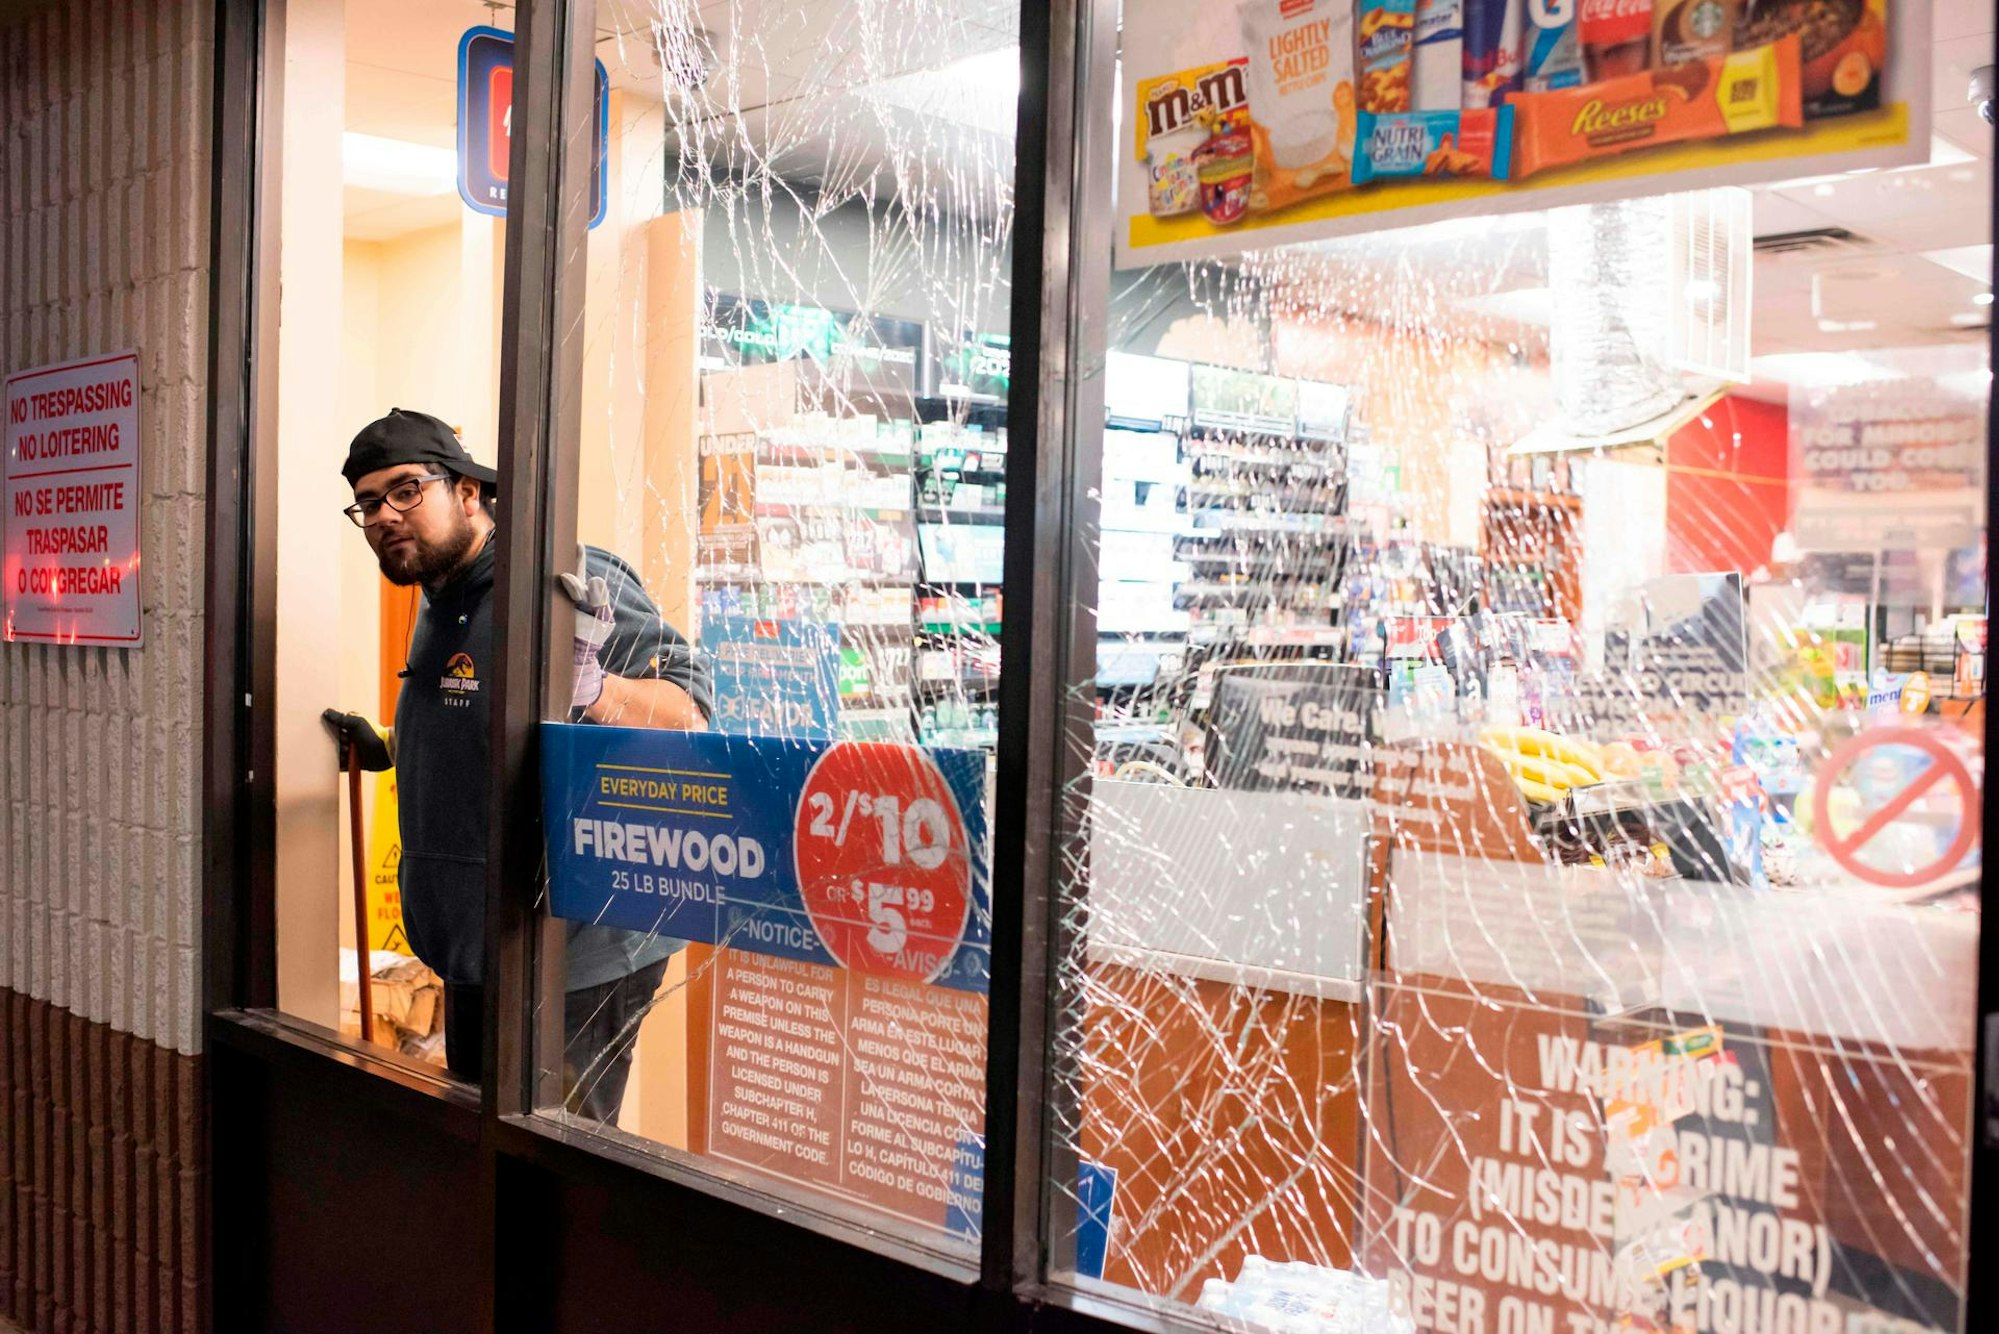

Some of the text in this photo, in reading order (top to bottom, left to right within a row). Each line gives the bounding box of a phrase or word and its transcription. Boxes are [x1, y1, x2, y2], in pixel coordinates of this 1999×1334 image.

[1269, 16, 1330, 60] LIGHTLY
[1273, 46, 1330, 84] SALTED
[1372, 144, 1423, 163] GRAIN
[1373, 126, 1425, 146] NUTRI
[10, 378, 133, 424] NO TRESPASSING
[19, 423, 120, 462] NO LOITERING
[15, 482, 124, 517] NO SE PERMITE
[26, 525, 109, 555] TRASPASAR
[18, 566, 121, 595] O CONGREGAR
[600, 776, 728, 806] EVERYDAY PRICE
[573, 817, 765, 880] FIREWOOD
[611, 870, 726, 907] 25 LB BUNDLE
[728, 948, 833, 981] IT IS UNLAWFUL FOR
[727, 968, 834, 1002] A PERSON TO CARRY
[865, 978, 980, 1014] ES ILEGAL QUE UNA
[730, 988, 829, 1022] A WEAPON ON THIS
[862, 998, 919, 1024] PERSONA
[920, 1010, 961, 1033] PORTE
[723, 1005, 836, 1044] PREMISE UNLESS THE
[851, 1017, 981, 1060] ARMA EN ESTE LUGAR
[719, 1023, 840, 1066] WEAPON IS A HANDGUN
[858, 1038, 986, 1082] MENOS QUE EL ARMA
[727, 1045, 829, 1084] AND THE PERSON IS
[732, 1065, 821, 1102] LICENSED UNDER
[853, 1060, 876, 1076] SEA
[878, 1065, 895, 1081] UN
[898, 1070, 933, 1091] ARMA
[934, 1079, 976, 1101] CORTA
[1537, 1032, 1760, 1126] WARNING:
[734, 1085, 804, 1117] SUBCHAPTER
[860, 1101, 885, 1121] UNA
[887, 1109, 942, 1137] LICENCIA
[861, 1081, 978, 1125] LA PERSONA TENGA
[721, 1121, 794, 1155] GOVERNMENT
[722, 1101, 830, 1145] CHAPTER 411 OF THE
[851, 1120, 892, 1143] FORME
[893, 1133, 910, 1149] AL
[1499, 1098, 1541, 1156] IT
[1552, 1108, 1592, 1168] IS
[847, 1139, 863, 1155] LO
[941, 1167, 960, 1185] 411
[848, 1160, 982, 1213] CÓDIGO DE GOBIERNO
[1397, 1205, 1442, 1267] TO
[1467, 1156, 1832, 1299] (MISDEANOR)
